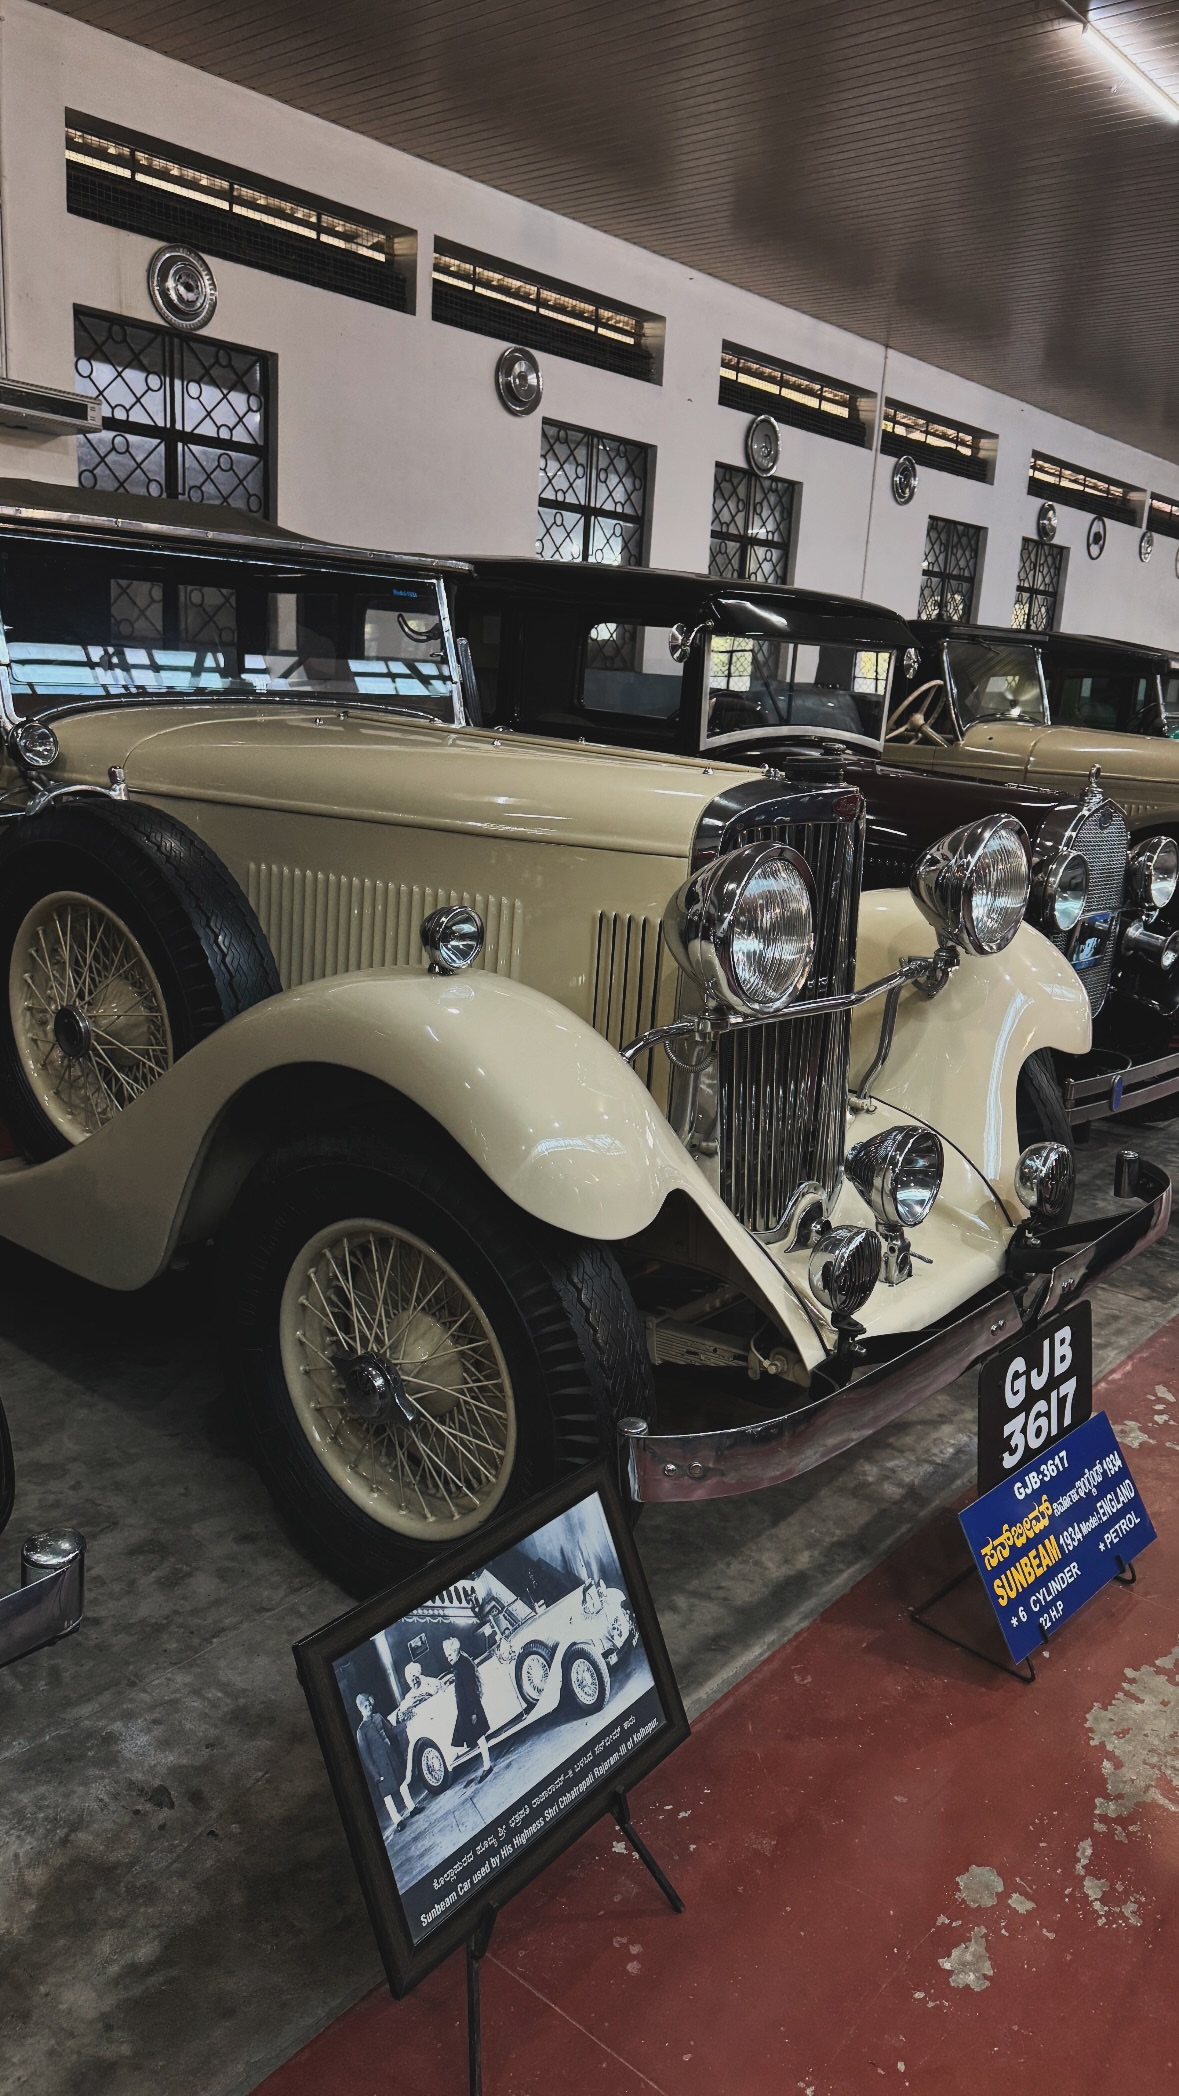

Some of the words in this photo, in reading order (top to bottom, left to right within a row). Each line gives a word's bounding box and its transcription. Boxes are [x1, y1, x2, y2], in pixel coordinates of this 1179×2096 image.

[1005, 1326, 1073, 1409] GJB
[1002, 1376, 1077, 1469] 3617
[1013, 1449, 1069, 1501] GJB-3617
[1102, 1450, 1124, 1478] 1934
[993, 1534, 1063, 1607] SUNBEAM
[1058, 1522, 1084, 1555] 1934
[1103, 1509, 1142, 1550] PETROL
[1017, 1605, 1029, 1623] 6
[1029, 1561, 1082, 1612] CYLINDER
[420, 1891, 458, 1928] Sunbeam
[457, 1878, 472, 1896] Car
[472, 1860, 491, 1885] used
[489, 1854, 502, 1869] by
[500, 1842, 515, 1860] His
[512, 1817, 545, 1849] Highness
[544, 1802, 560, 1822] Shri
[558, 1771, 595, 1809] Chhatrapati
[626, 1736, 635, 1750] of
